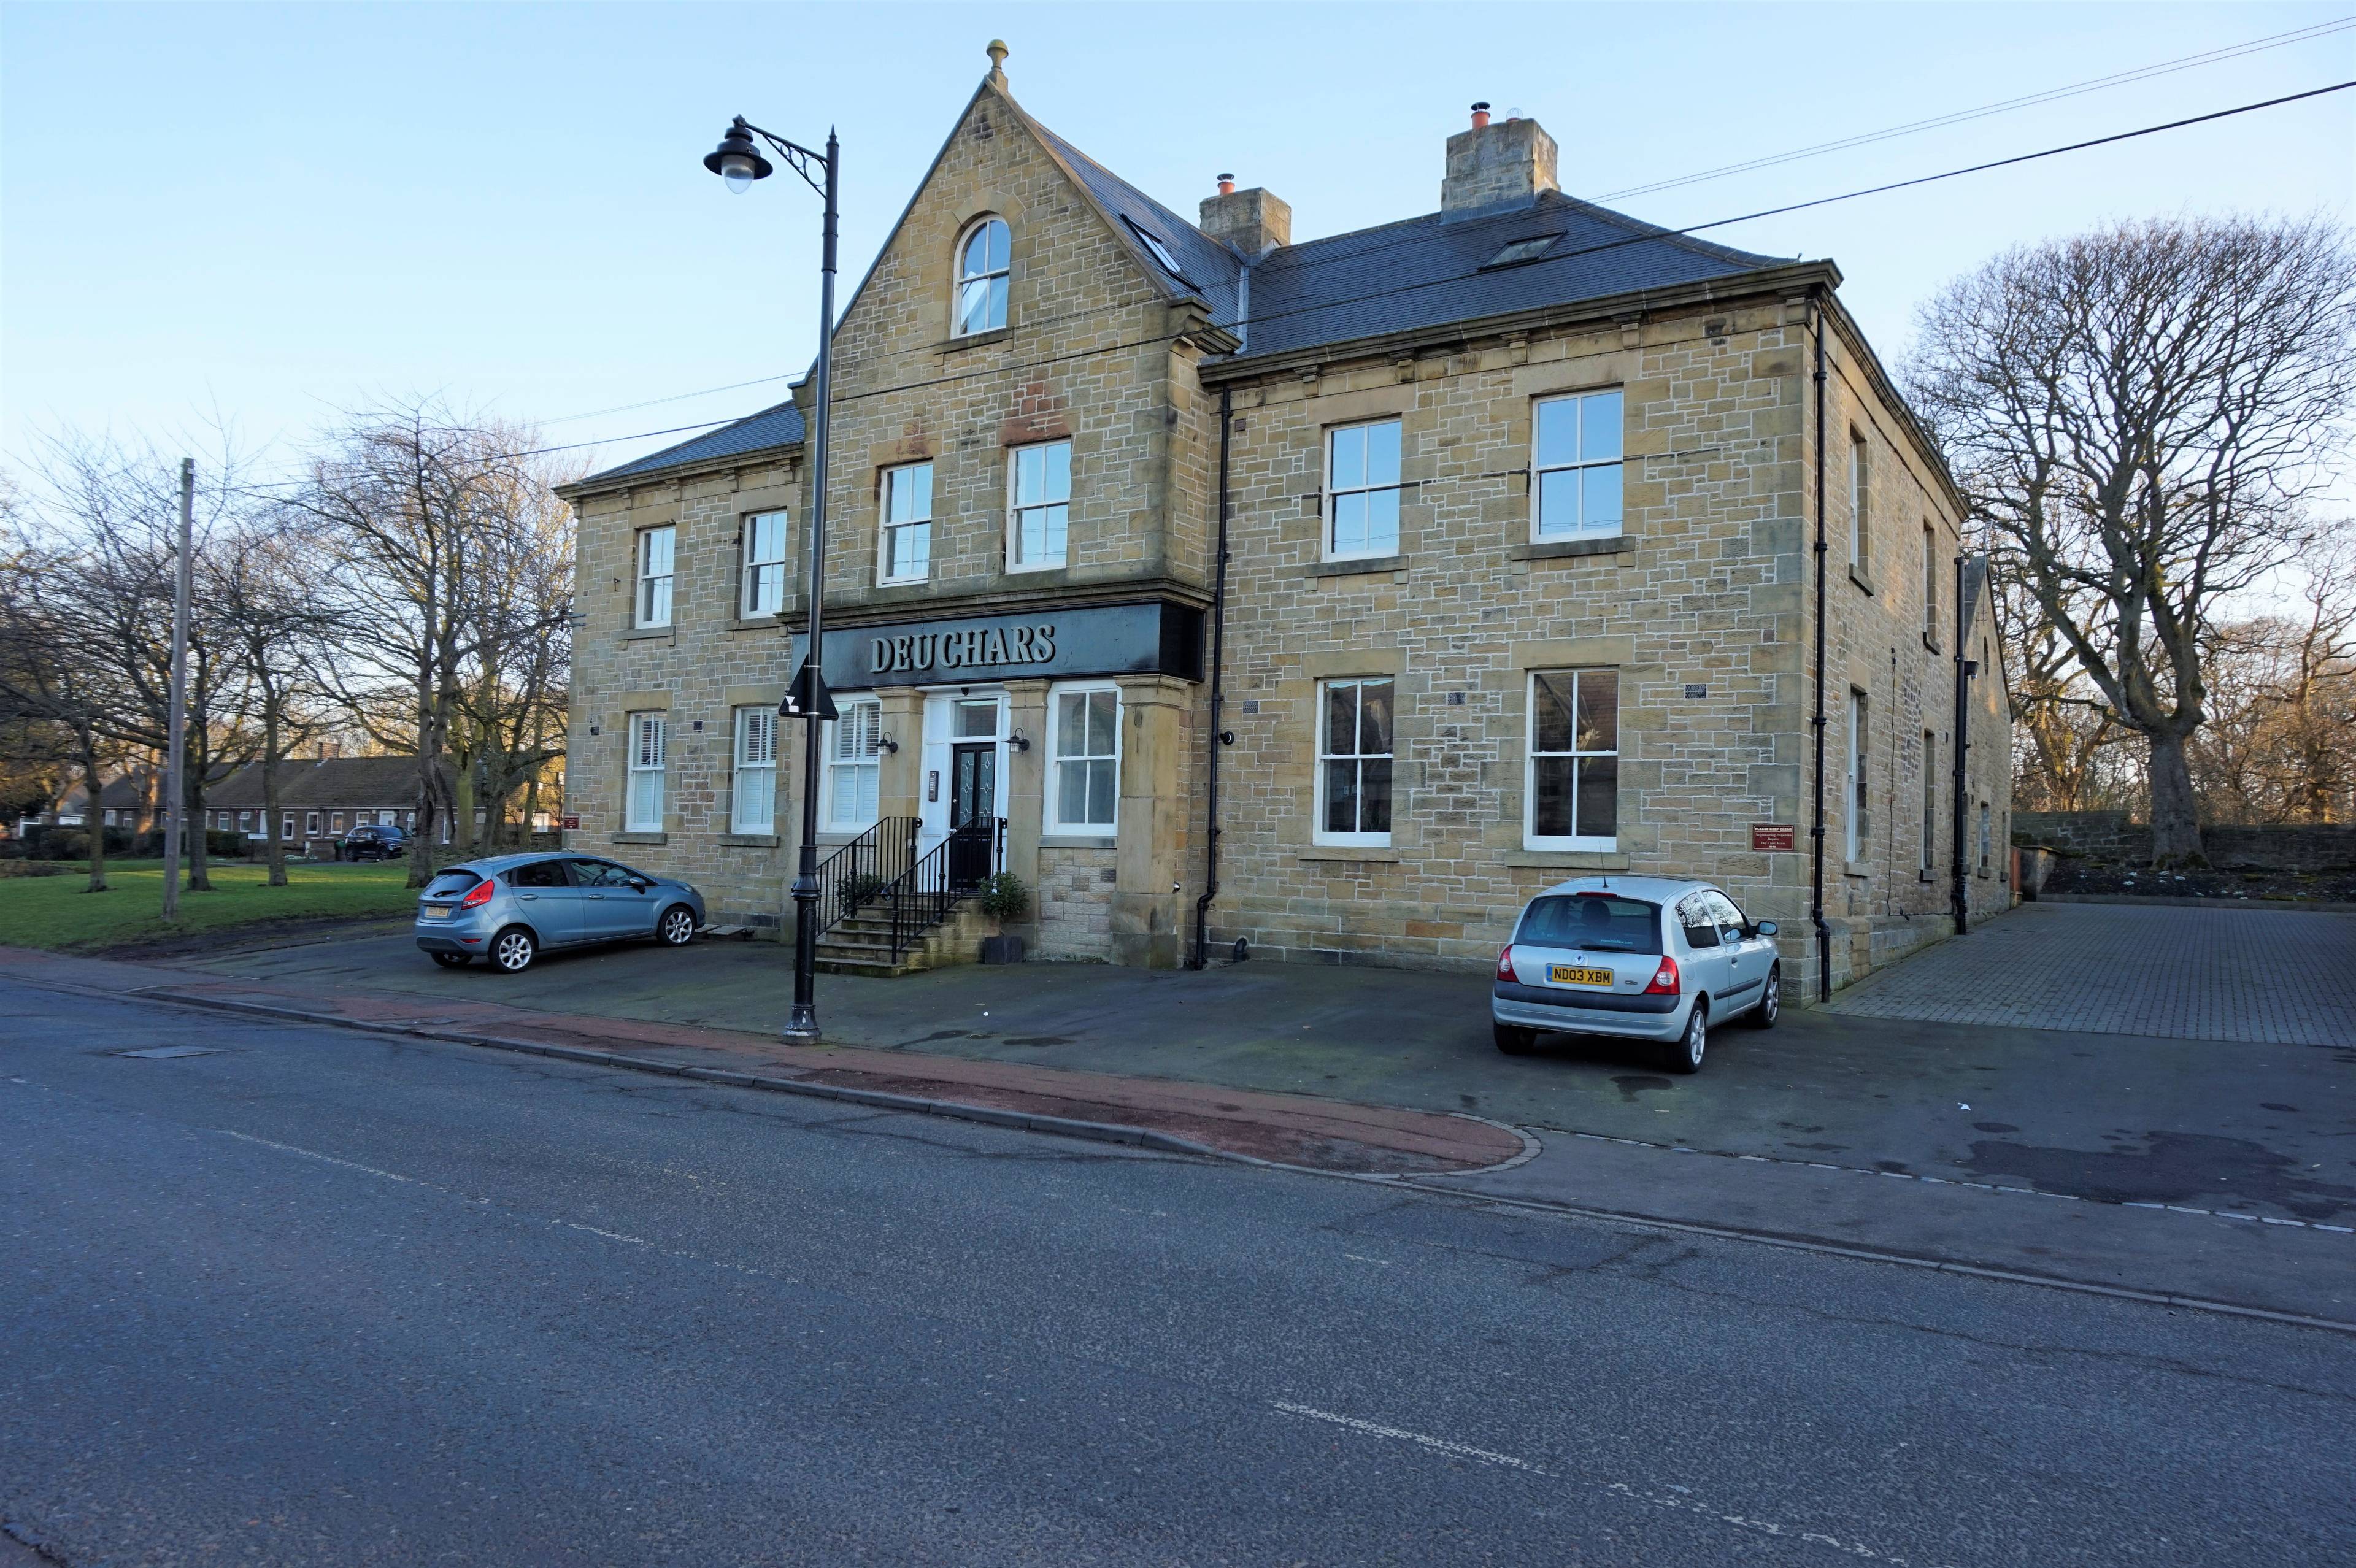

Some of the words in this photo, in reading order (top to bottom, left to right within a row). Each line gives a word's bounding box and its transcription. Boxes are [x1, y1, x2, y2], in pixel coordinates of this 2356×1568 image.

[869, 625, 1056, 674] DEUCHARS
[1554, 968, 1584, 981] ND03
[1587, 970, 1611, 983] XBM
